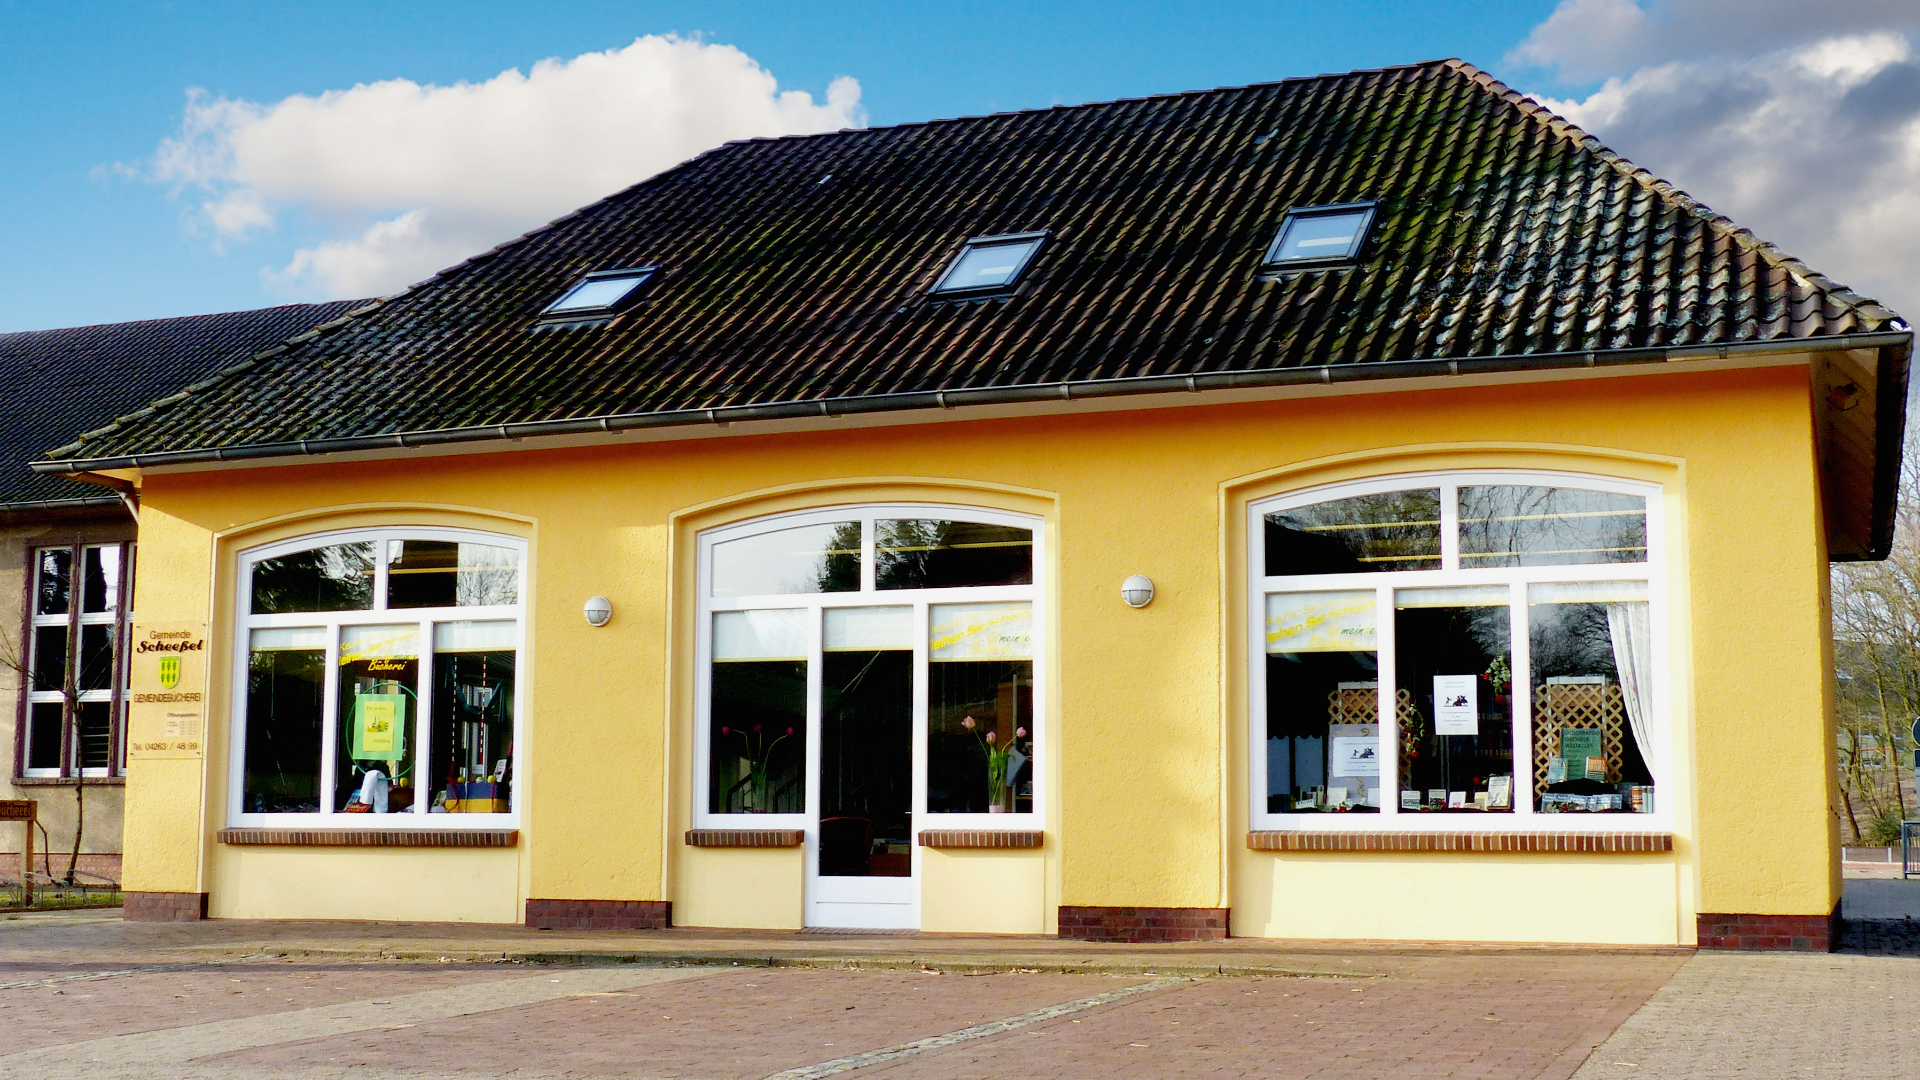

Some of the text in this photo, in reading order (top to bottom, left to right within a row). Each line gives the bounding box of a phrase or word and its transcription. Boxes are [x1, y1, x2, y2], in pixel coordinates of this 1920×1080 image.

[149, 630, 191, 640] Gemeinde
[136, 639, 204, 653] Scheeßel
[176, 742, 186, 750] 48
[188, 742, 198, 750] 99
